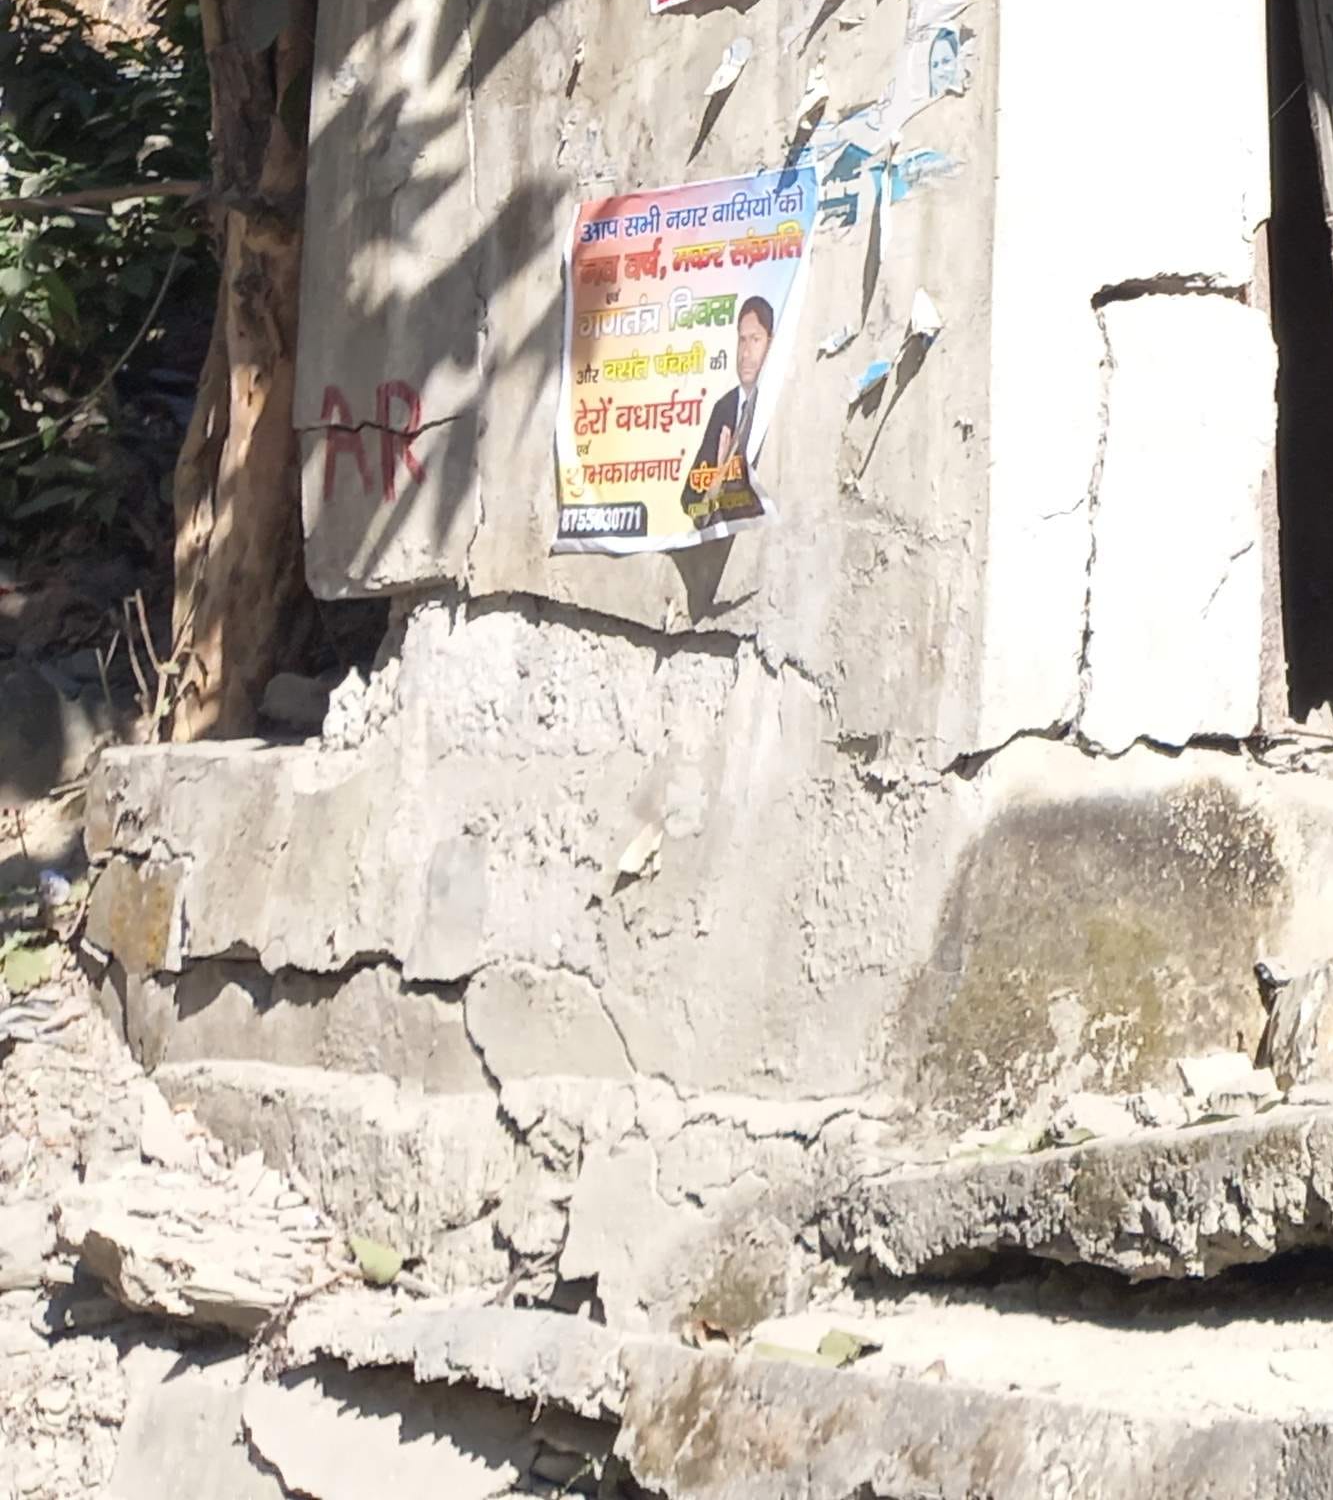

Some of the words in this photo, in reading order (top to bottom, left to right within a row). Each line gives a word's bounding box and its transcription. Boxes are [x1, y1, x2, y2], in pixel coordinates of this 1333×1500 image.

[580, 219, 618, 243] आप
[624, 205, 661, 238] सभी
[666, 206, 708, 231] नगर
[778, 185, 804, 213] को
[672, 240, 727, 273] मकर
[578, 293, 661, 340] गणतंत्र
[668, 285, 738, 332] दिवस
[576, 363, 599, 385] और
[710, 350, 728, 371] की
[321, 379, 426, 503] AR
